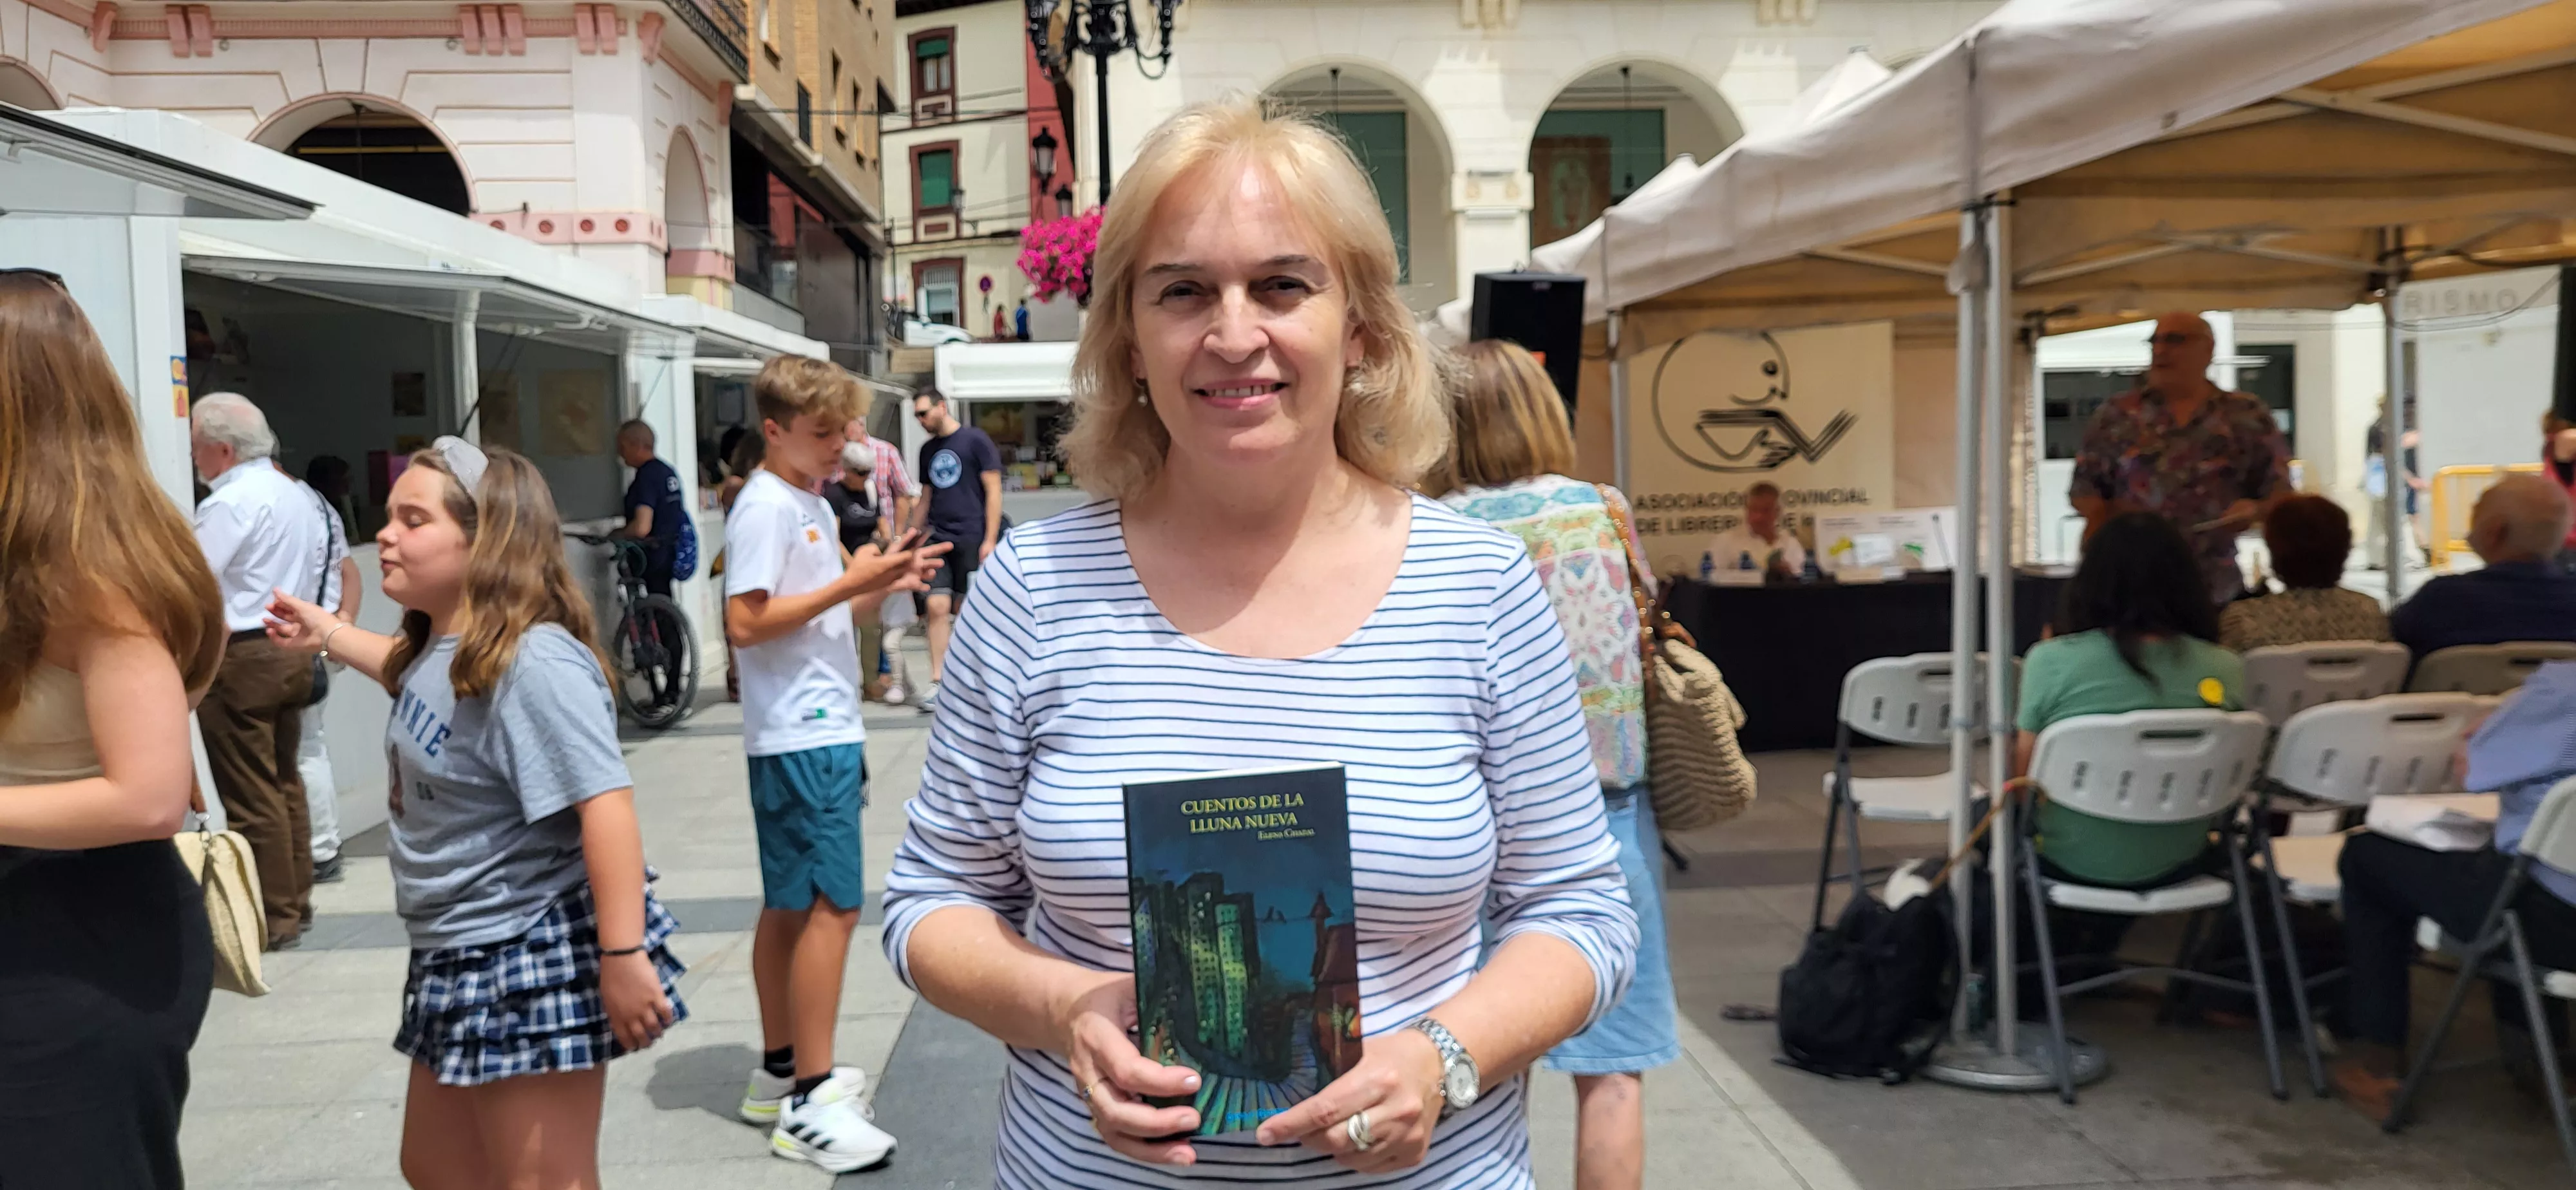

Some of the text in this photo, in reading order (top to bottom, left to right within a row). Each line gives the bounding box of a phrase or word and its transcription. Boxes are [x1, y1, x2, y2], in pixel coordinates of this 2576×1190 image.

[2404, 288, 2517, 314] RISMO
[1635, 487, 1871, 512] ASOCIACIÓ OVINCIAL
[1636, 516, 1661, 536] DE
[1667, 515, 1741, 535] LIBRER
[1181, 792, 1304, 815] CUENTOS DE LA
[1189, 812, 1298, 834] LLUNA NUEVA
